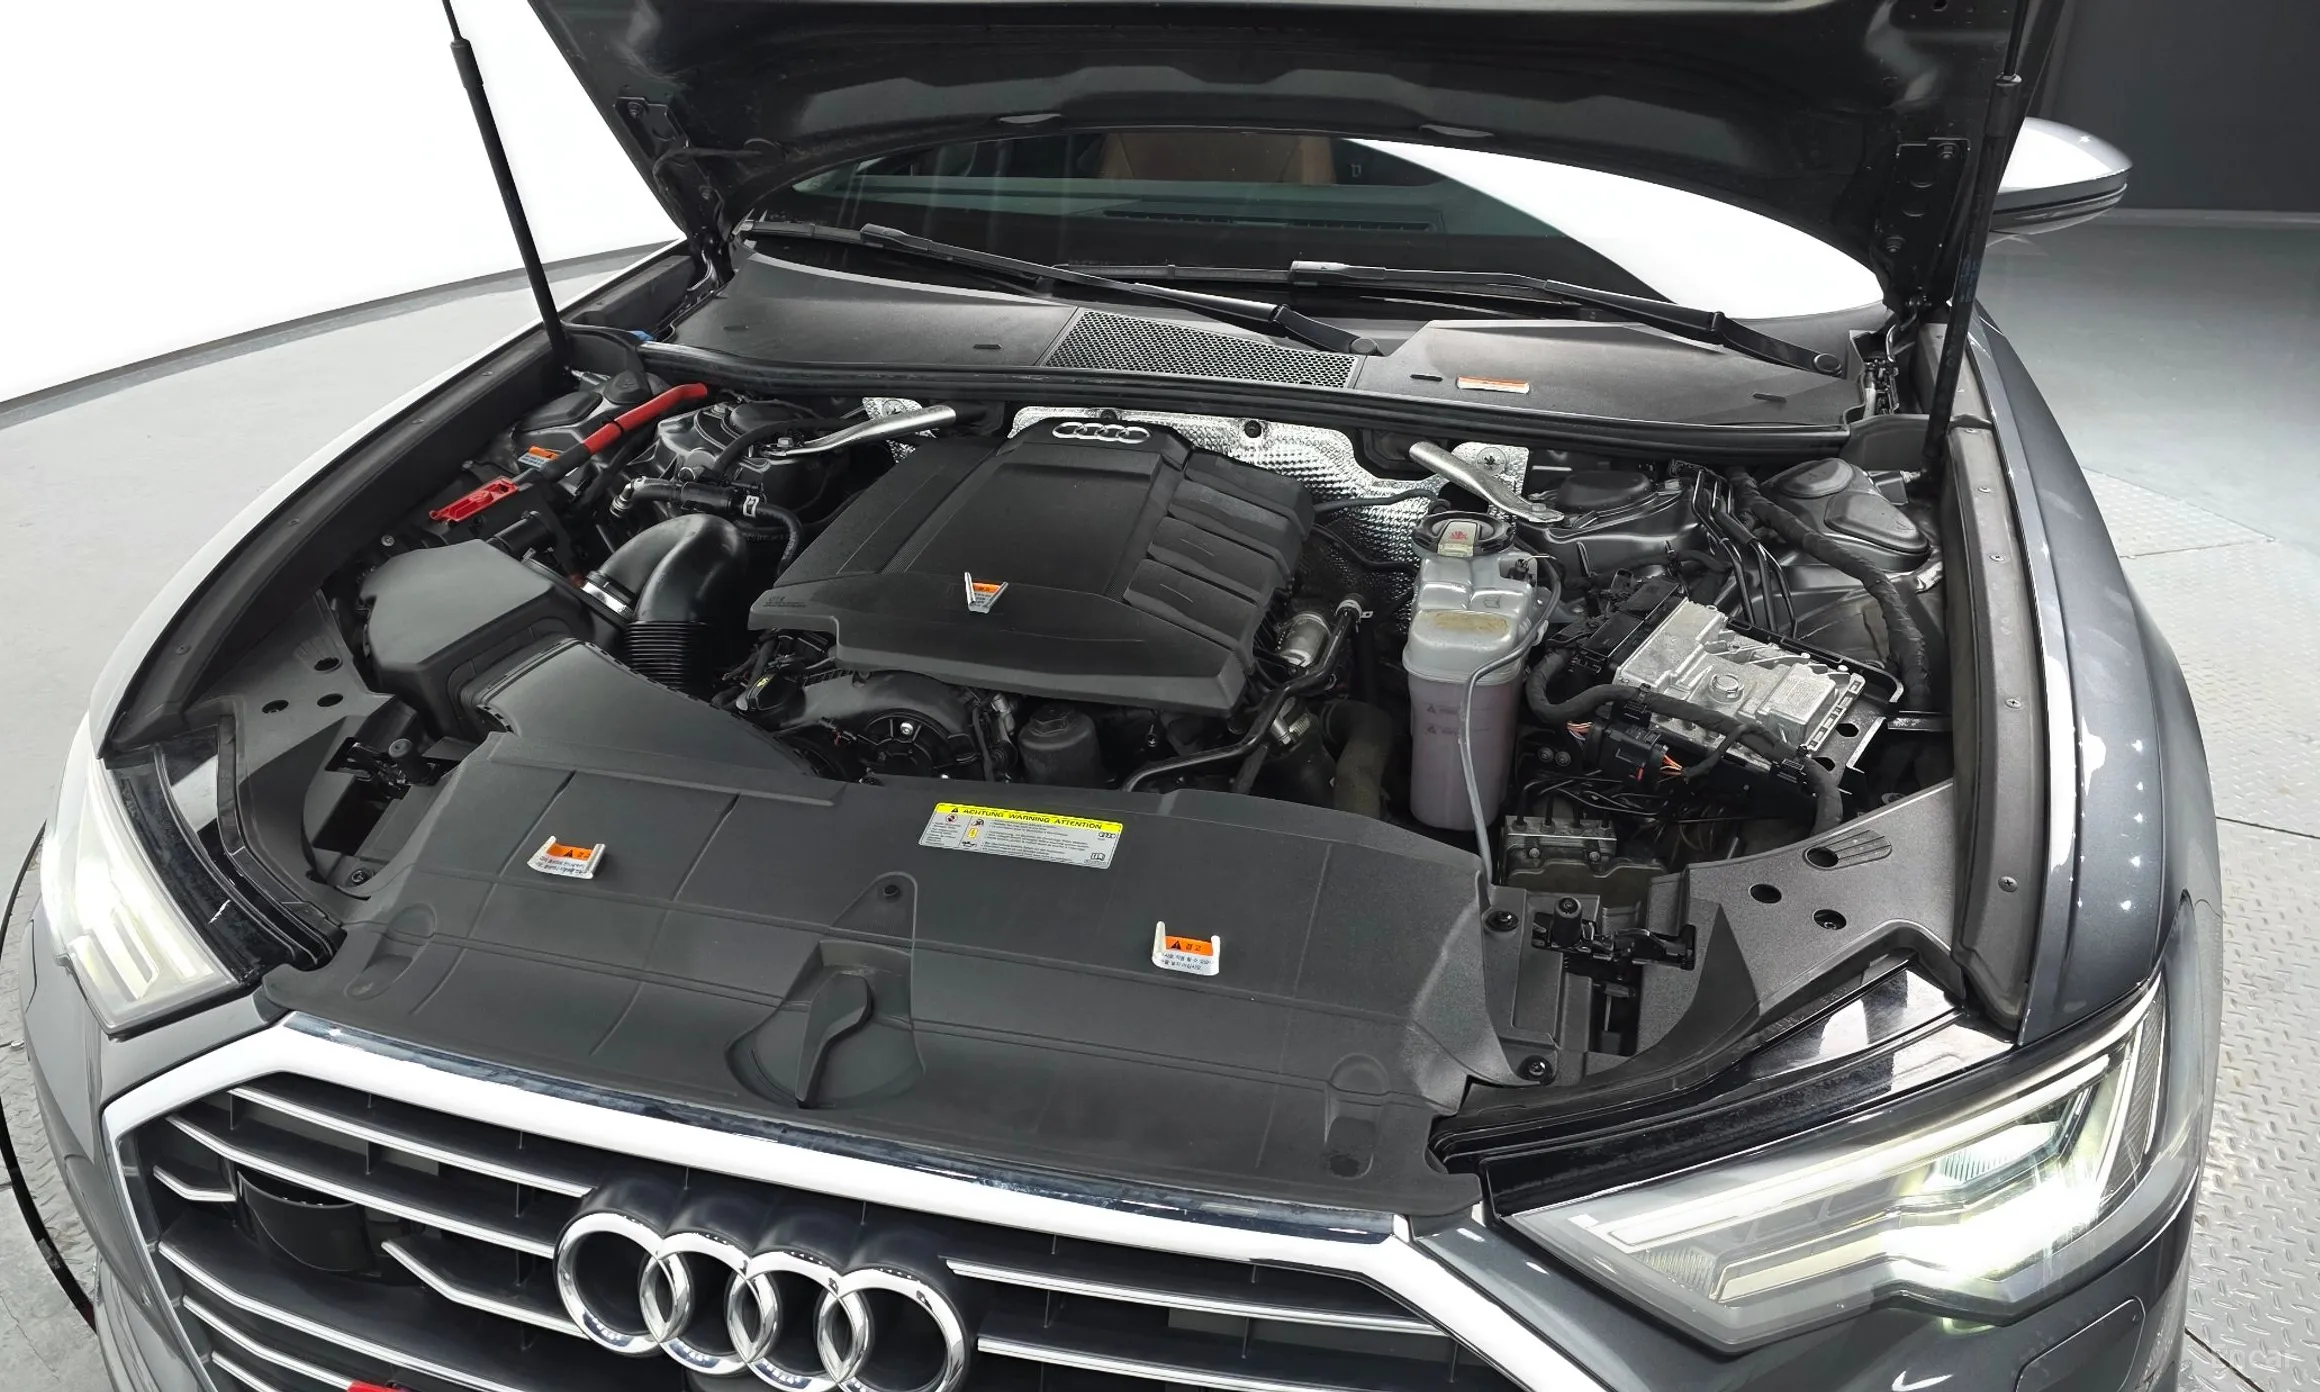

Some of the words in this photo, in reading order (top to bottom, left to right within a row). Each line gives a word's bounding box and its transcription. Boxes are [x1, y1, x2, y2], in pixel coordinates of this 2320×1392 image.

[963, 808, 1004, 819] ACHTUNG
[1009, 813, 1050, 824] WARNING
[1055, 818, 1103, 830] ATTENTION
